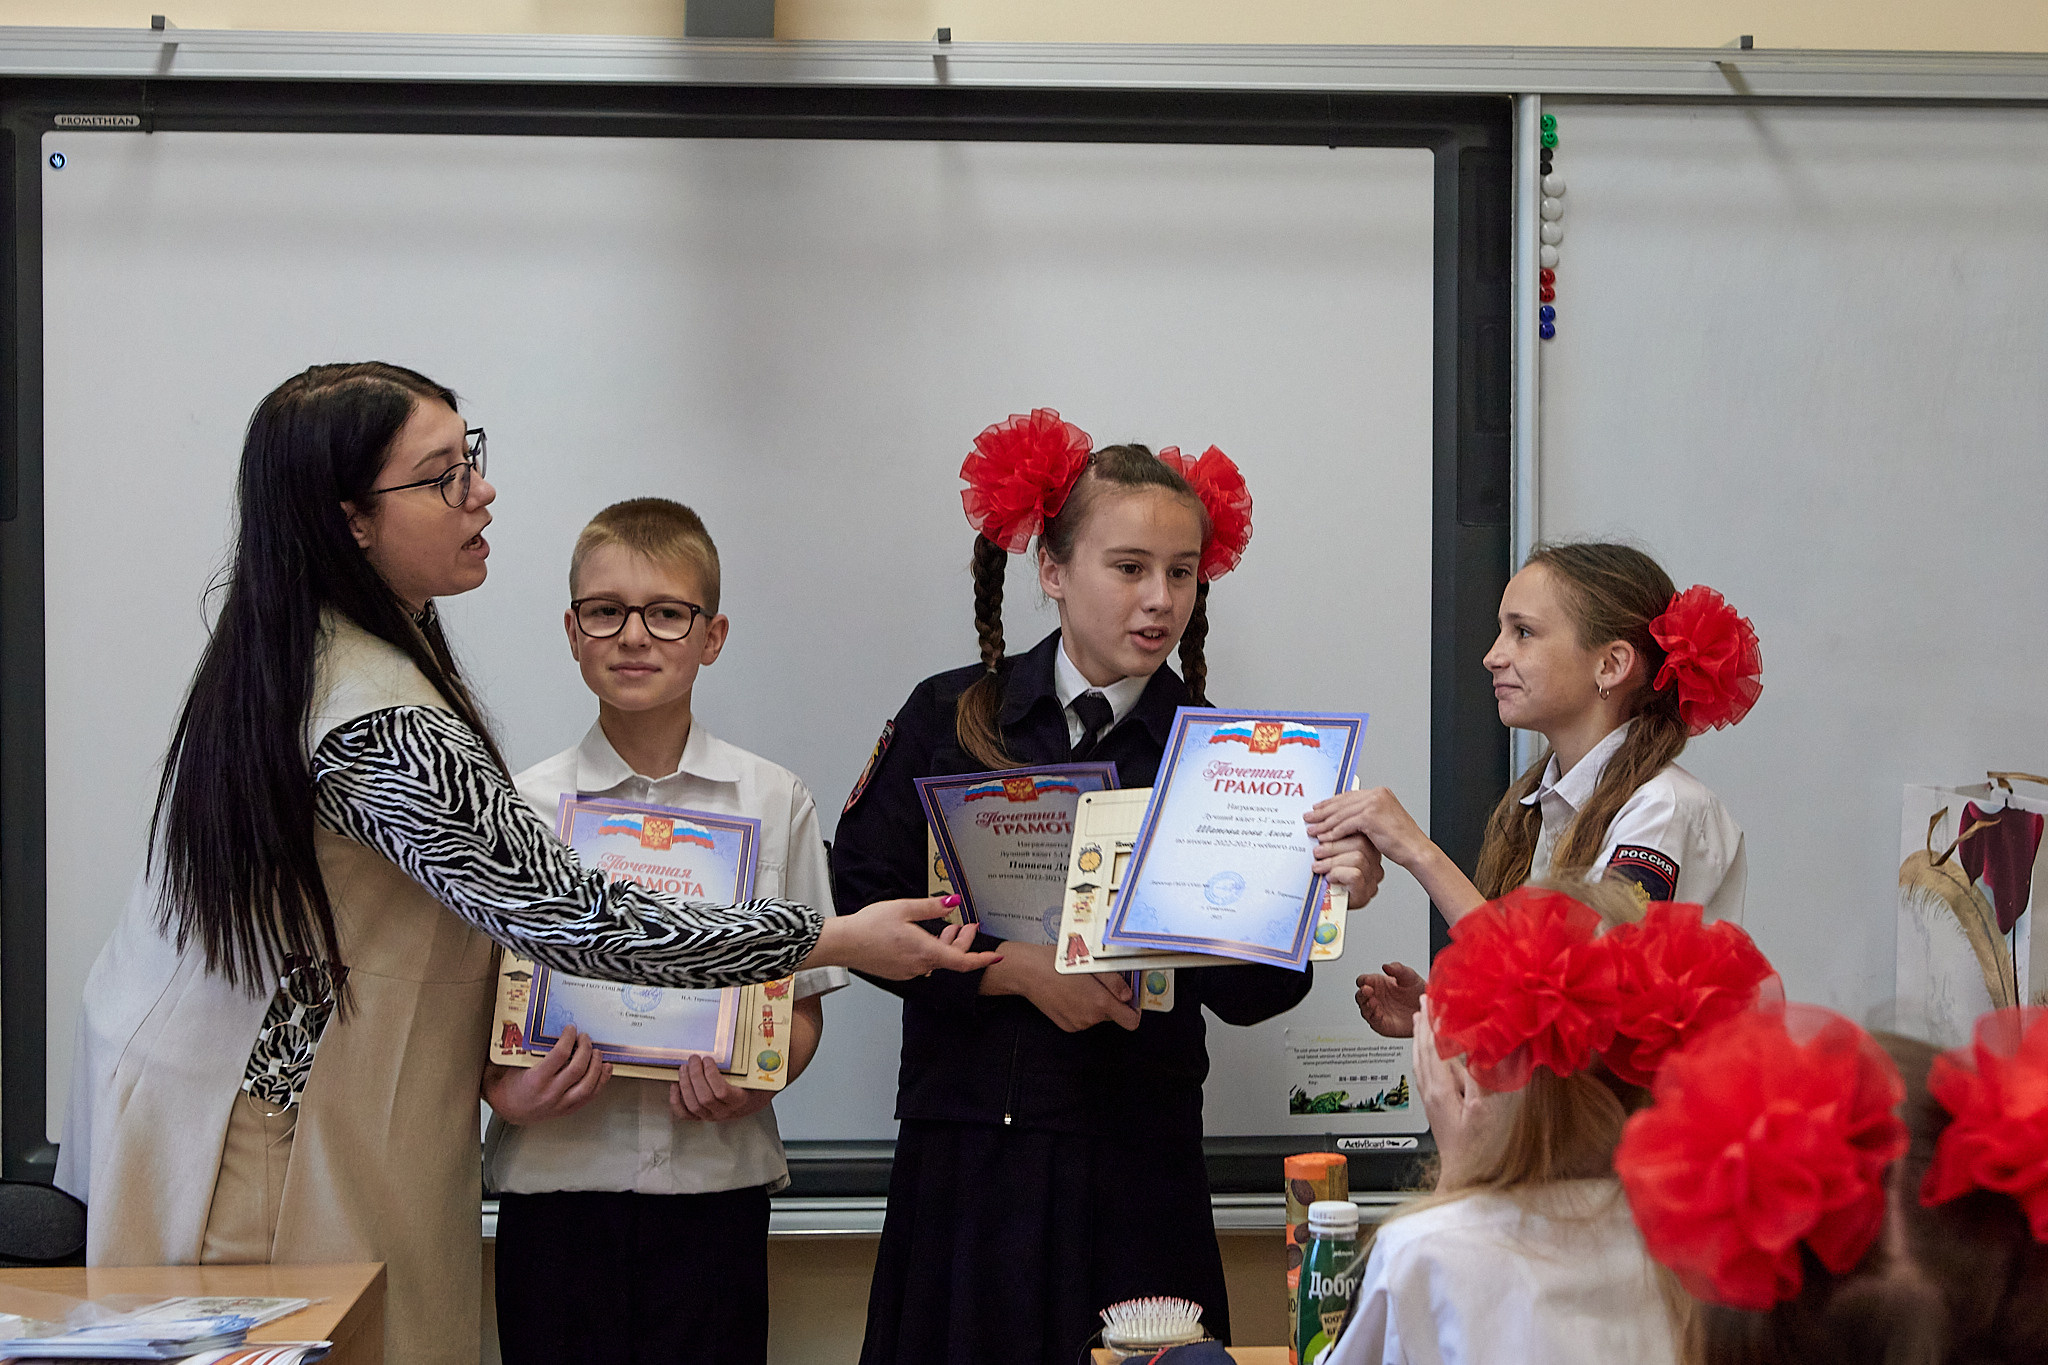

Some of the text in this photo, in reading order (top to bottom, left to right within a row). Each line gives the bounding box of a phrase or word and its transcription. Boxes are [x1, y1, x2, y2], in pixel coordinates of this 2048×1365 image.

[61, 116, 134, 126] PROMETHEAN
[1203, 759, 1295, 781] Почетная
[1213, 778, 1305, 797] ГРАМОТА
[975, 810, 1067, 829] Почетная
[993, 821, 1073, 837] ГРАМОТ
[597, 852, 692, 879] Почетная
[1618, 849, 1673, 876] РОССИЯ
[1344, 1138, 1385, 1149] ActivBoard
[1308, 1271, 1358, 1300] Добр
